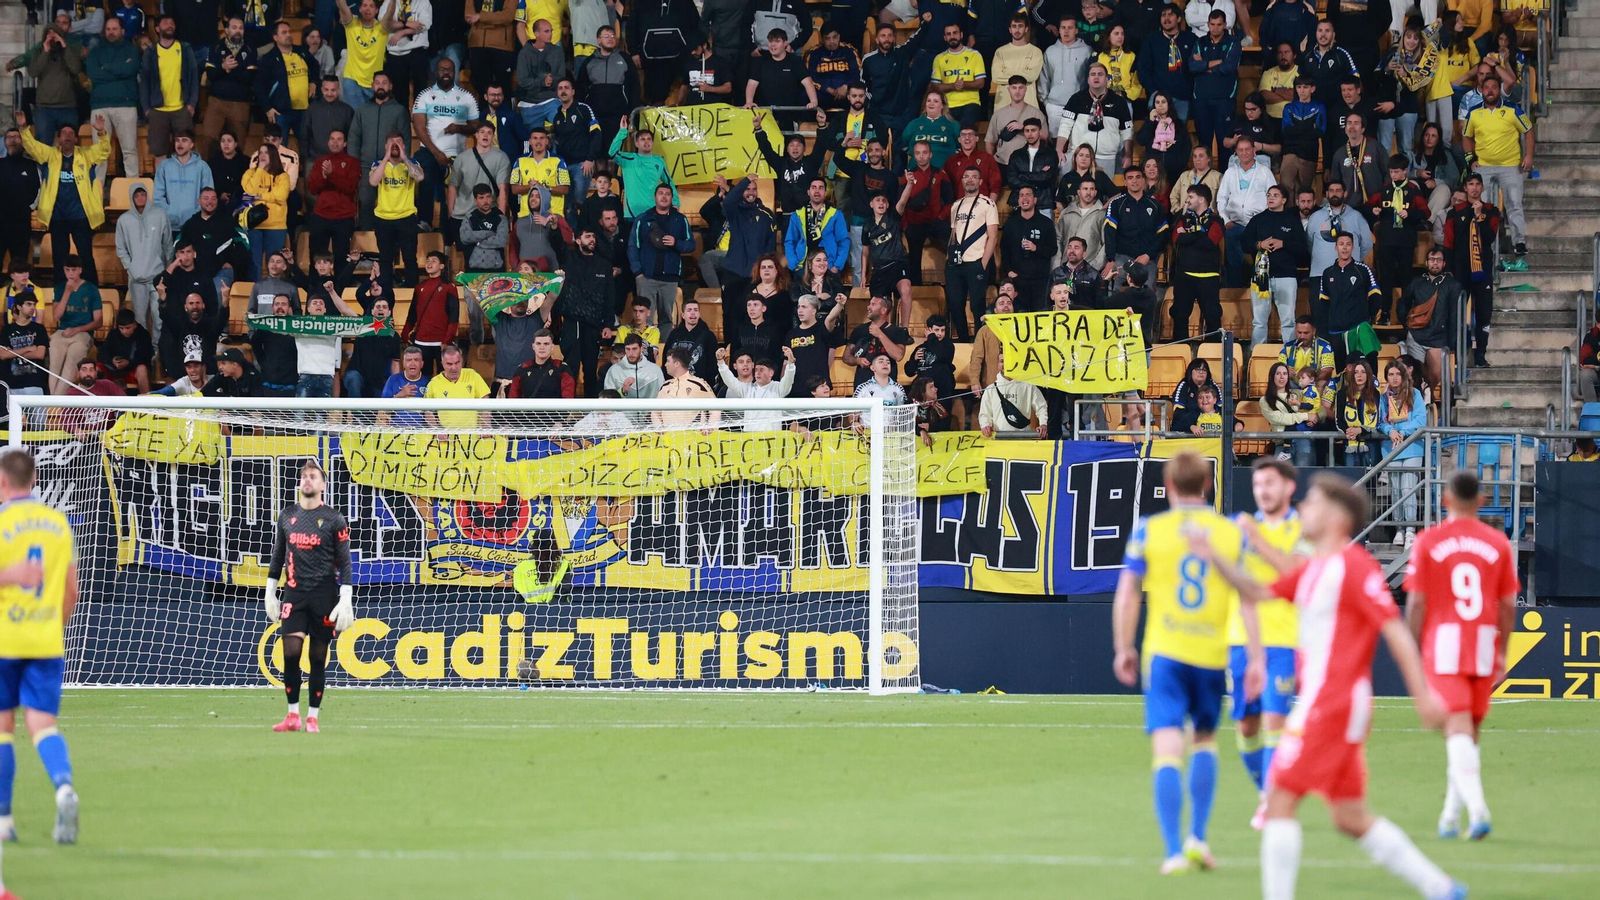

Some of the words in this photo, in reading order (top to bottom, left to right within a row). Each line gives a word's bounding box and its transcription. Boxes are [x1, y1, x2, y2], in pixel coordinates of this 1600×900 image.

[944, 69, 970, 77] DIGI
[915, 134, 948, 142] DIGI
[1103, 314, 1139, 341] DEL
[110, 427, 165, 453] ETE
[562, 463, 618, 488] DIZ
[852, 462, 941, 487] CDIZ
[1179, 554, 1206, 611] 8
[1450, 562, 1484, 621] 9
